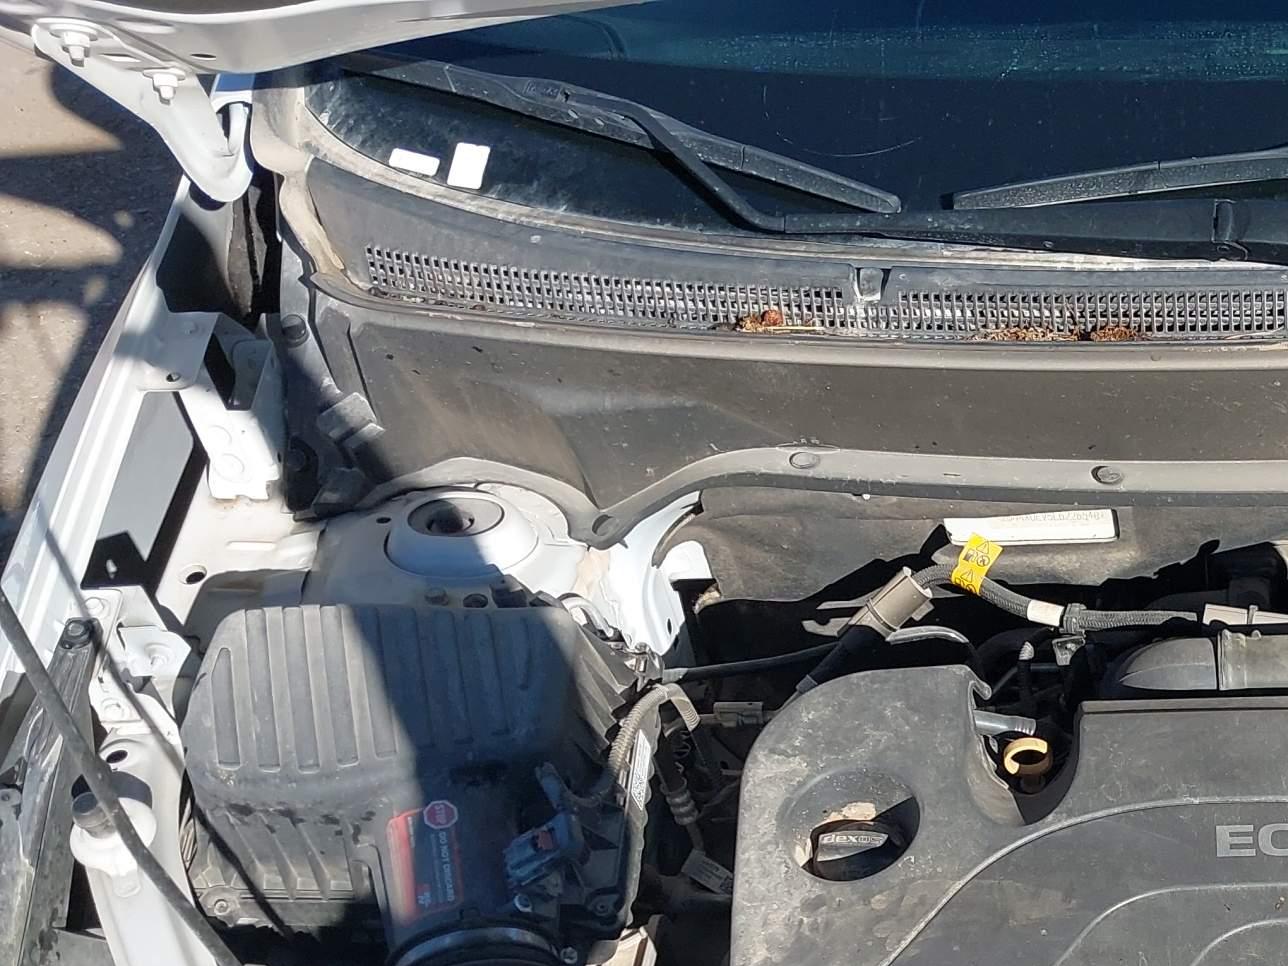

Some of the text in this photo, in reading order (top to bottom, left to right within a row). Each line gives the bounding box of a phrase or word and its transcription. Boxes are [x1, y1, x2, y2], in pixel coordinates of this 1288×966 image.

[434, 803, 447, 825] STOP
[822, 833, 883, 845] dexos
[438, 831, 456, 902] DO NOT DISCARD
